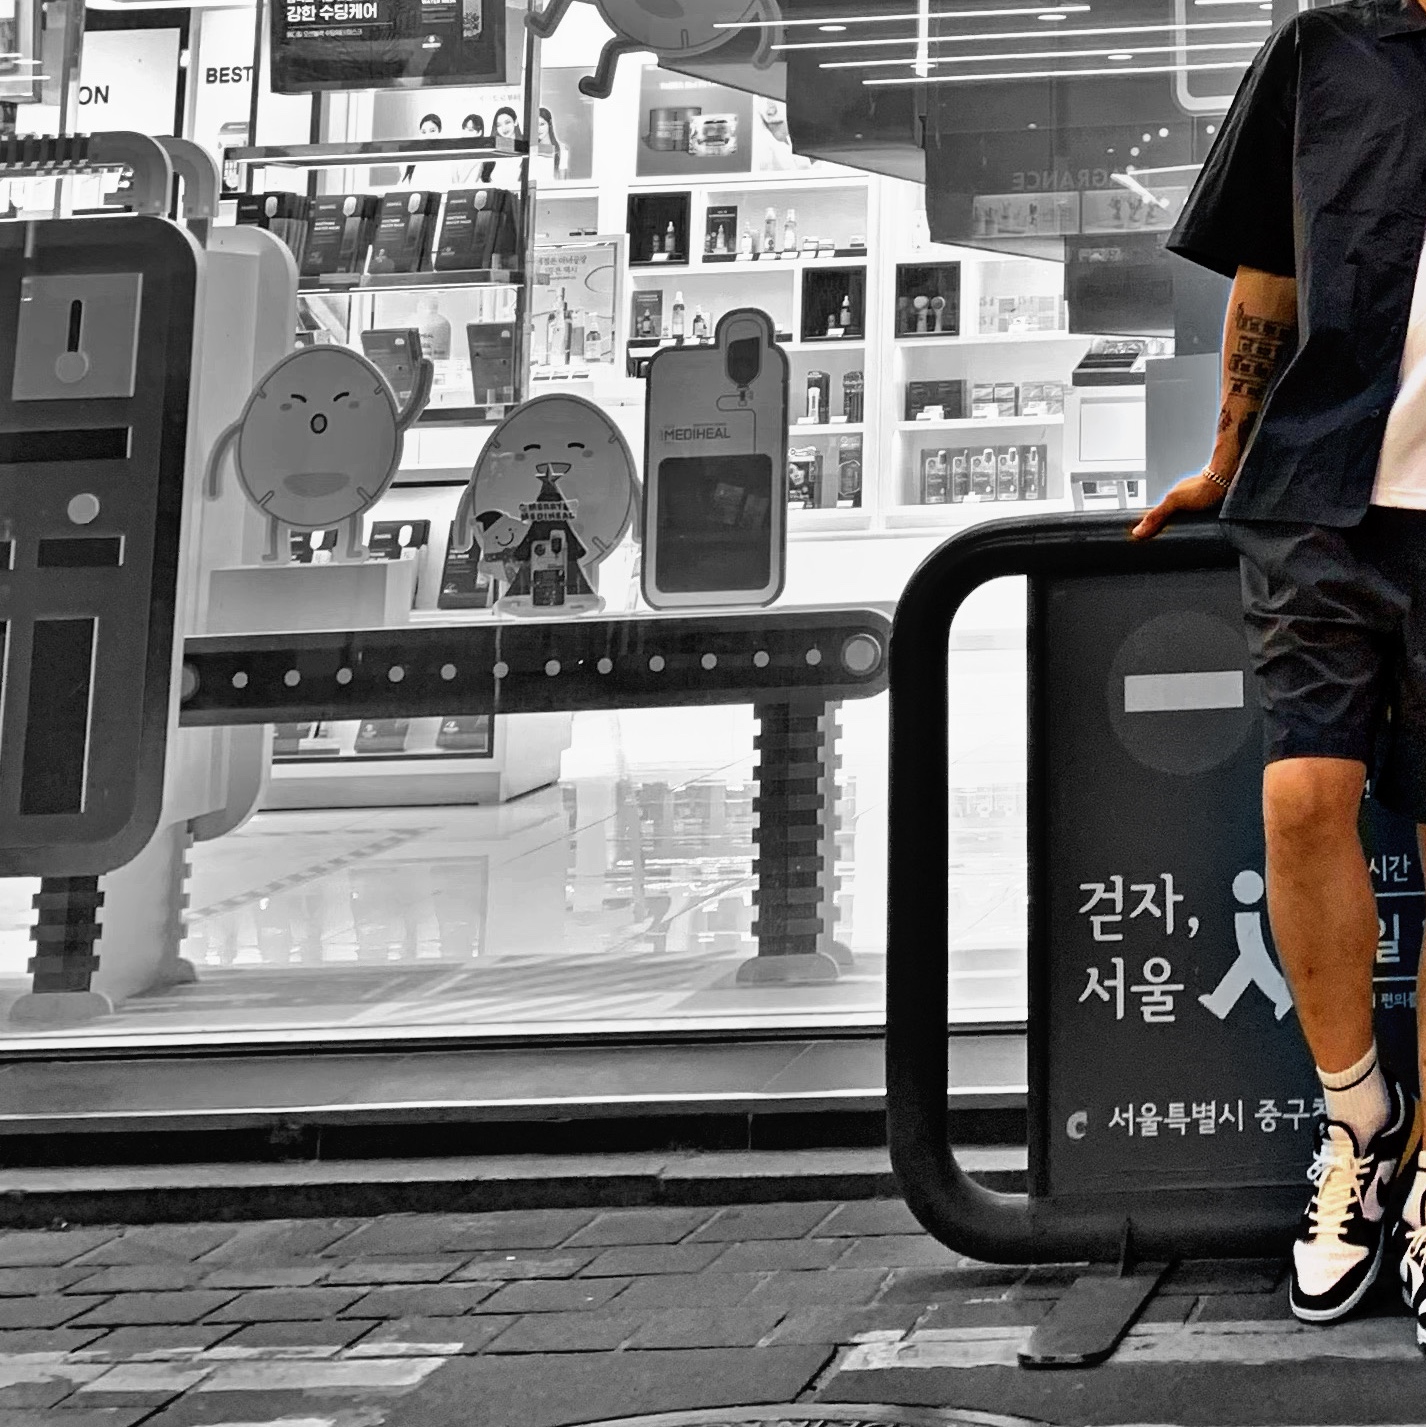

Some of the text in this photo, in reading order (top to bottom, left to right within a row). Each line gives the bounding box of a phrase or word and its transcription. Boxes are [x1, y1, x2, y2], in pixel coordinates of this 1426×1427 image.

[286, 2, 378, 22] 강한 수딩케어
[205, 66, 254, 85] BEST
[664, 427, 731, 441] MEDIHEAL
[1078, 873, 1200, 942] 걷자,
[1078, 957, 1185, 1023] 서울
[1108, 1099, 1244, 1137] 서울특별시
